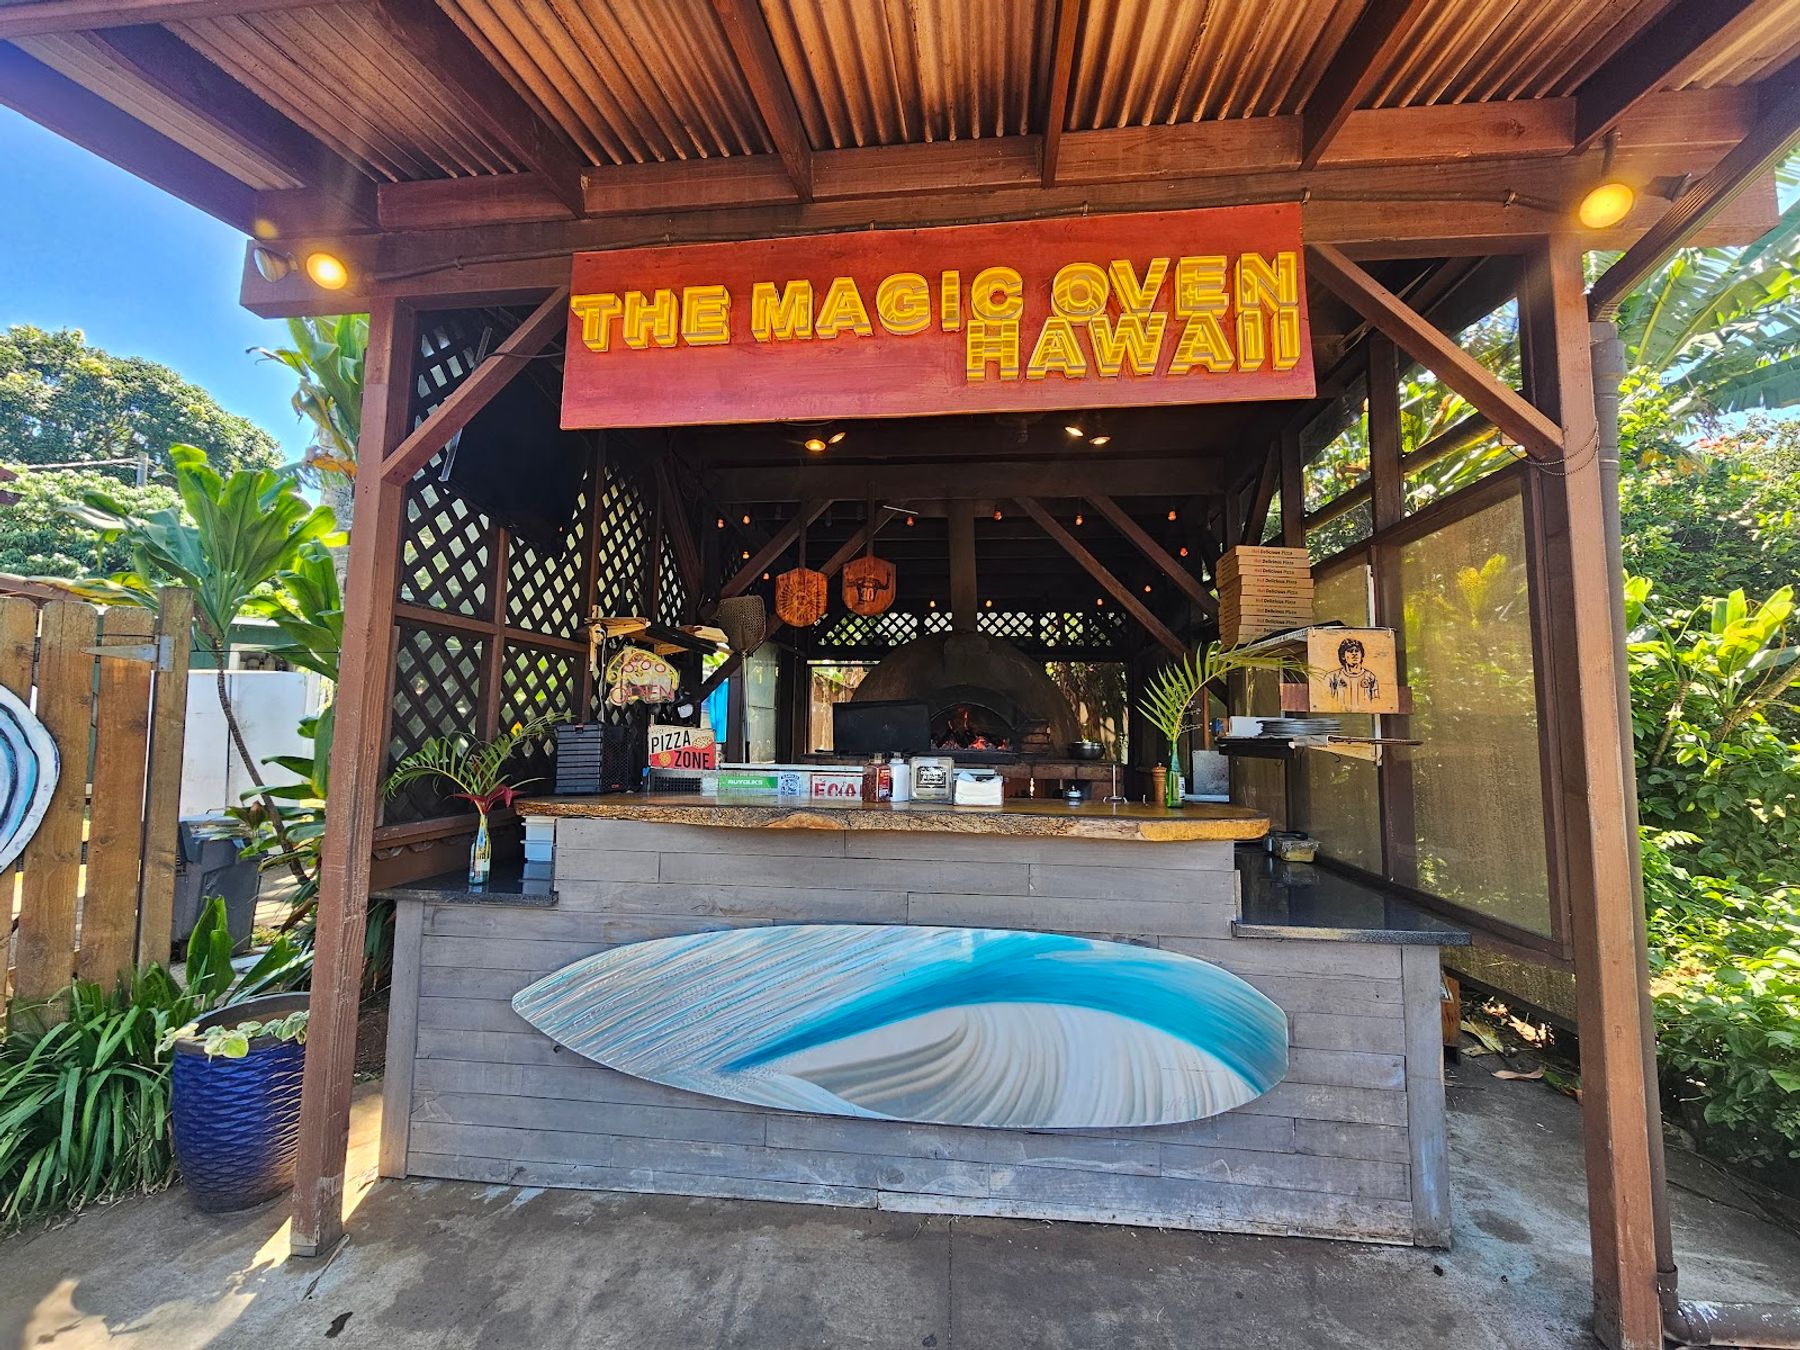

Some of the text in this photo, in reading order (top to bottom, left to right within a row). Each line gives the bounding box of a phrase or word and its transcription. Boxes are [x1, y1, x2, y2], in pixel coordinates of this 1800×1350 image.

[570, 251, 1298, 352] THE MAGIC OVEN
[966, 307, 1302, 382] HAWAII
[651, 730, 692, 754] PIZZA
[674, 750, 710, 770] ZONE
